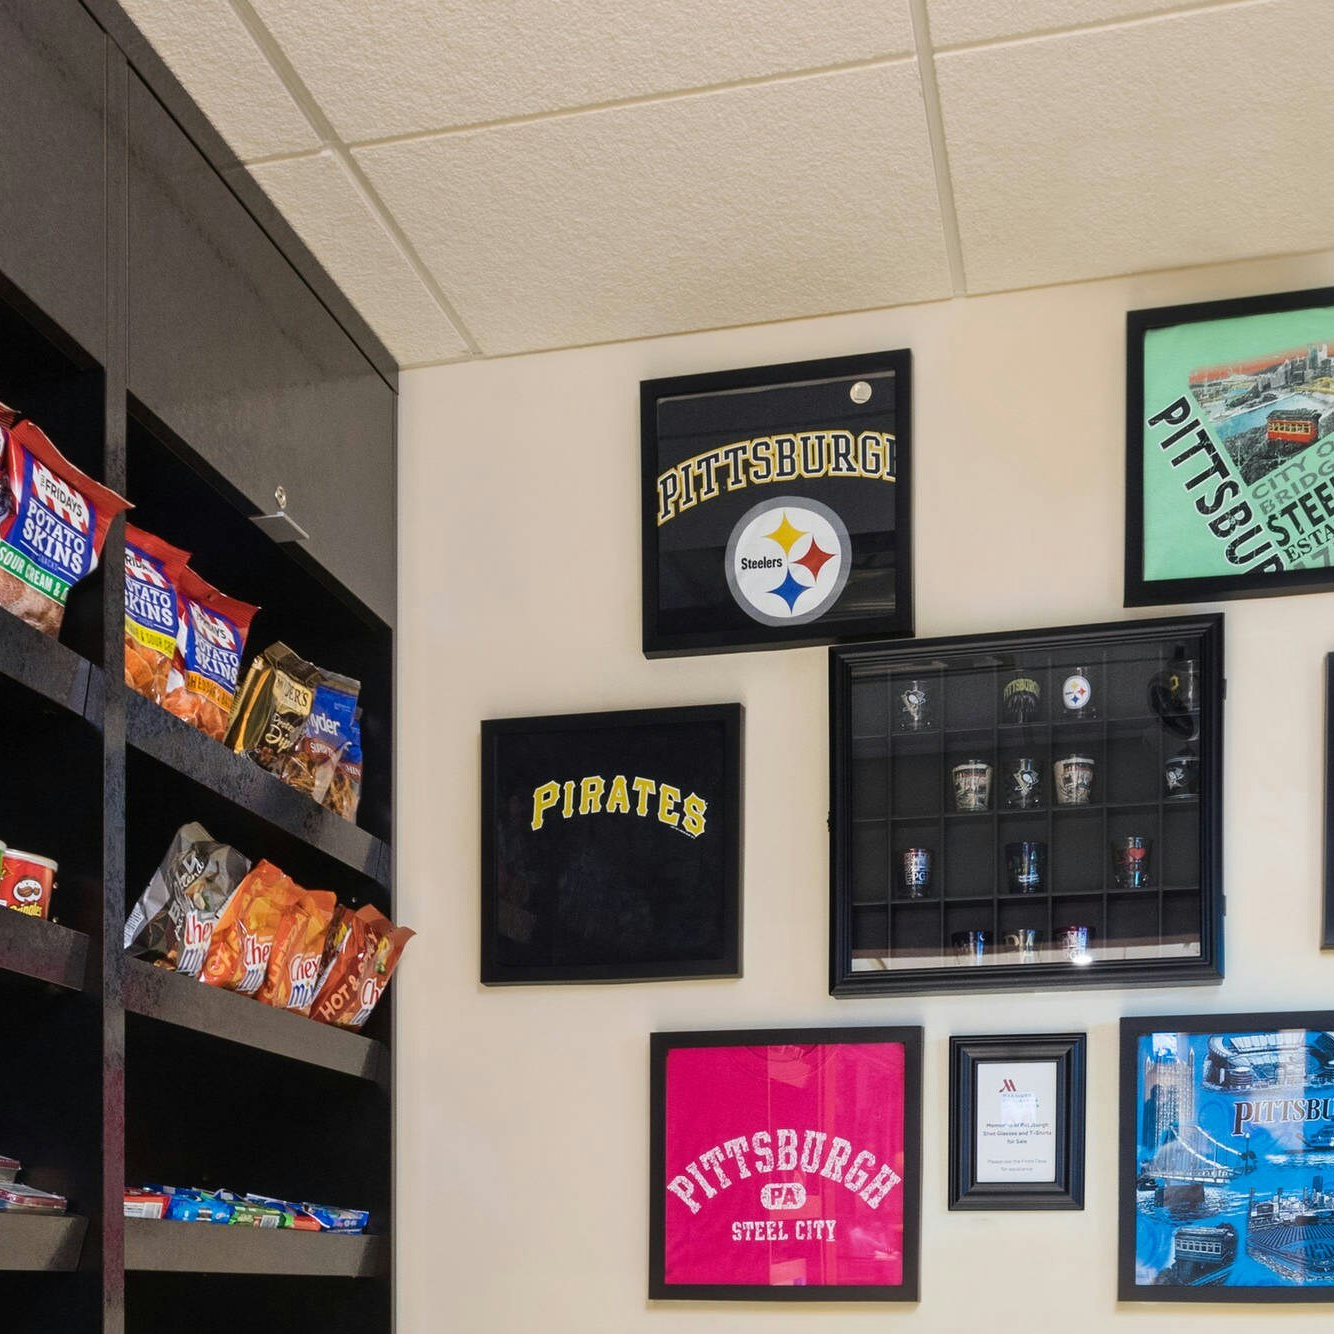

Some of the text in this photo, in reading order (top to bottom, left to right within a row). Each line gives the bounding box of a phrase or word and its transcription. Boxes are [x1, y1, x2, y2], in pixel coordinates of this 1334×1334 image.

[45, 479, 83, 519] FRIDAYS
[1252, 454, 1308, 499] CITY
[23, 518, 84, 575] SKINS
[26, 499, 86, 553] POTATO
[24, 561, 54, 594] CREAM
[740, 556, 783, 571] Steelers
[530, 775, 708, 838] PIRATES
[319, 973, 361, 1021] HOT &
[666, 1129, 902, 1215] PITTSBURGH
[770, 1187, 798, 1206] PA
[732, 1220, 837, 1242] STEEL CITY
